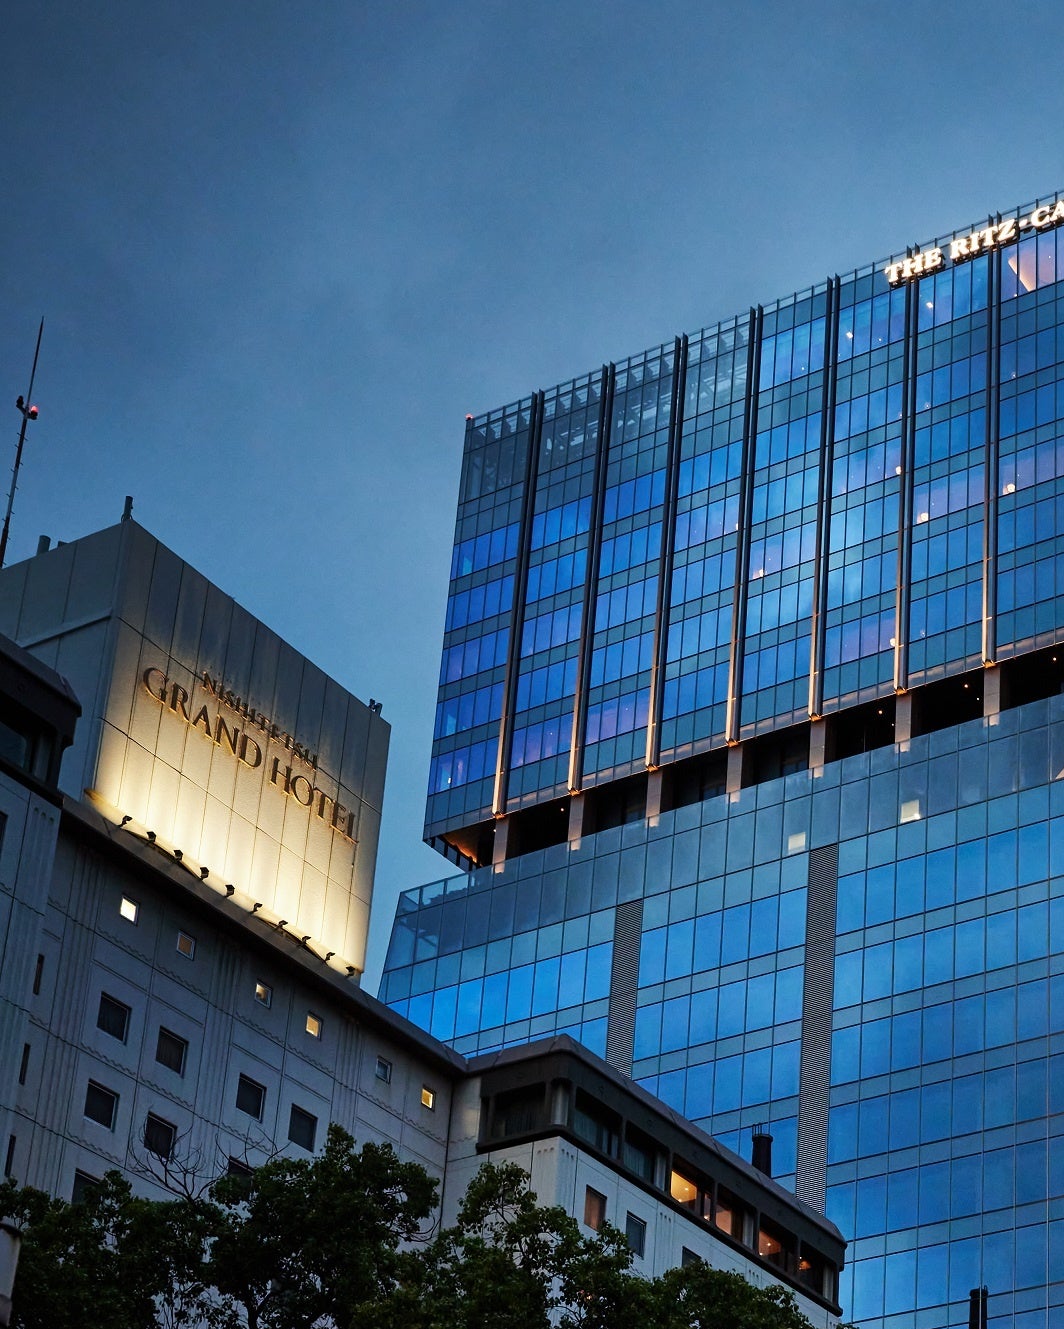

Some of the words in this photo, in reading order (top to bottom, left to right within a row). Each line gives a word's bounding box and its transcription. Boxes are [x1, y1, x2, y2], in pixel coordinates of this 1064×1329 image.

[884, 247, 942, 283] THE
[142, 666, 262, 769] GRAND
[270, 756, 358, 844] HOTEL
